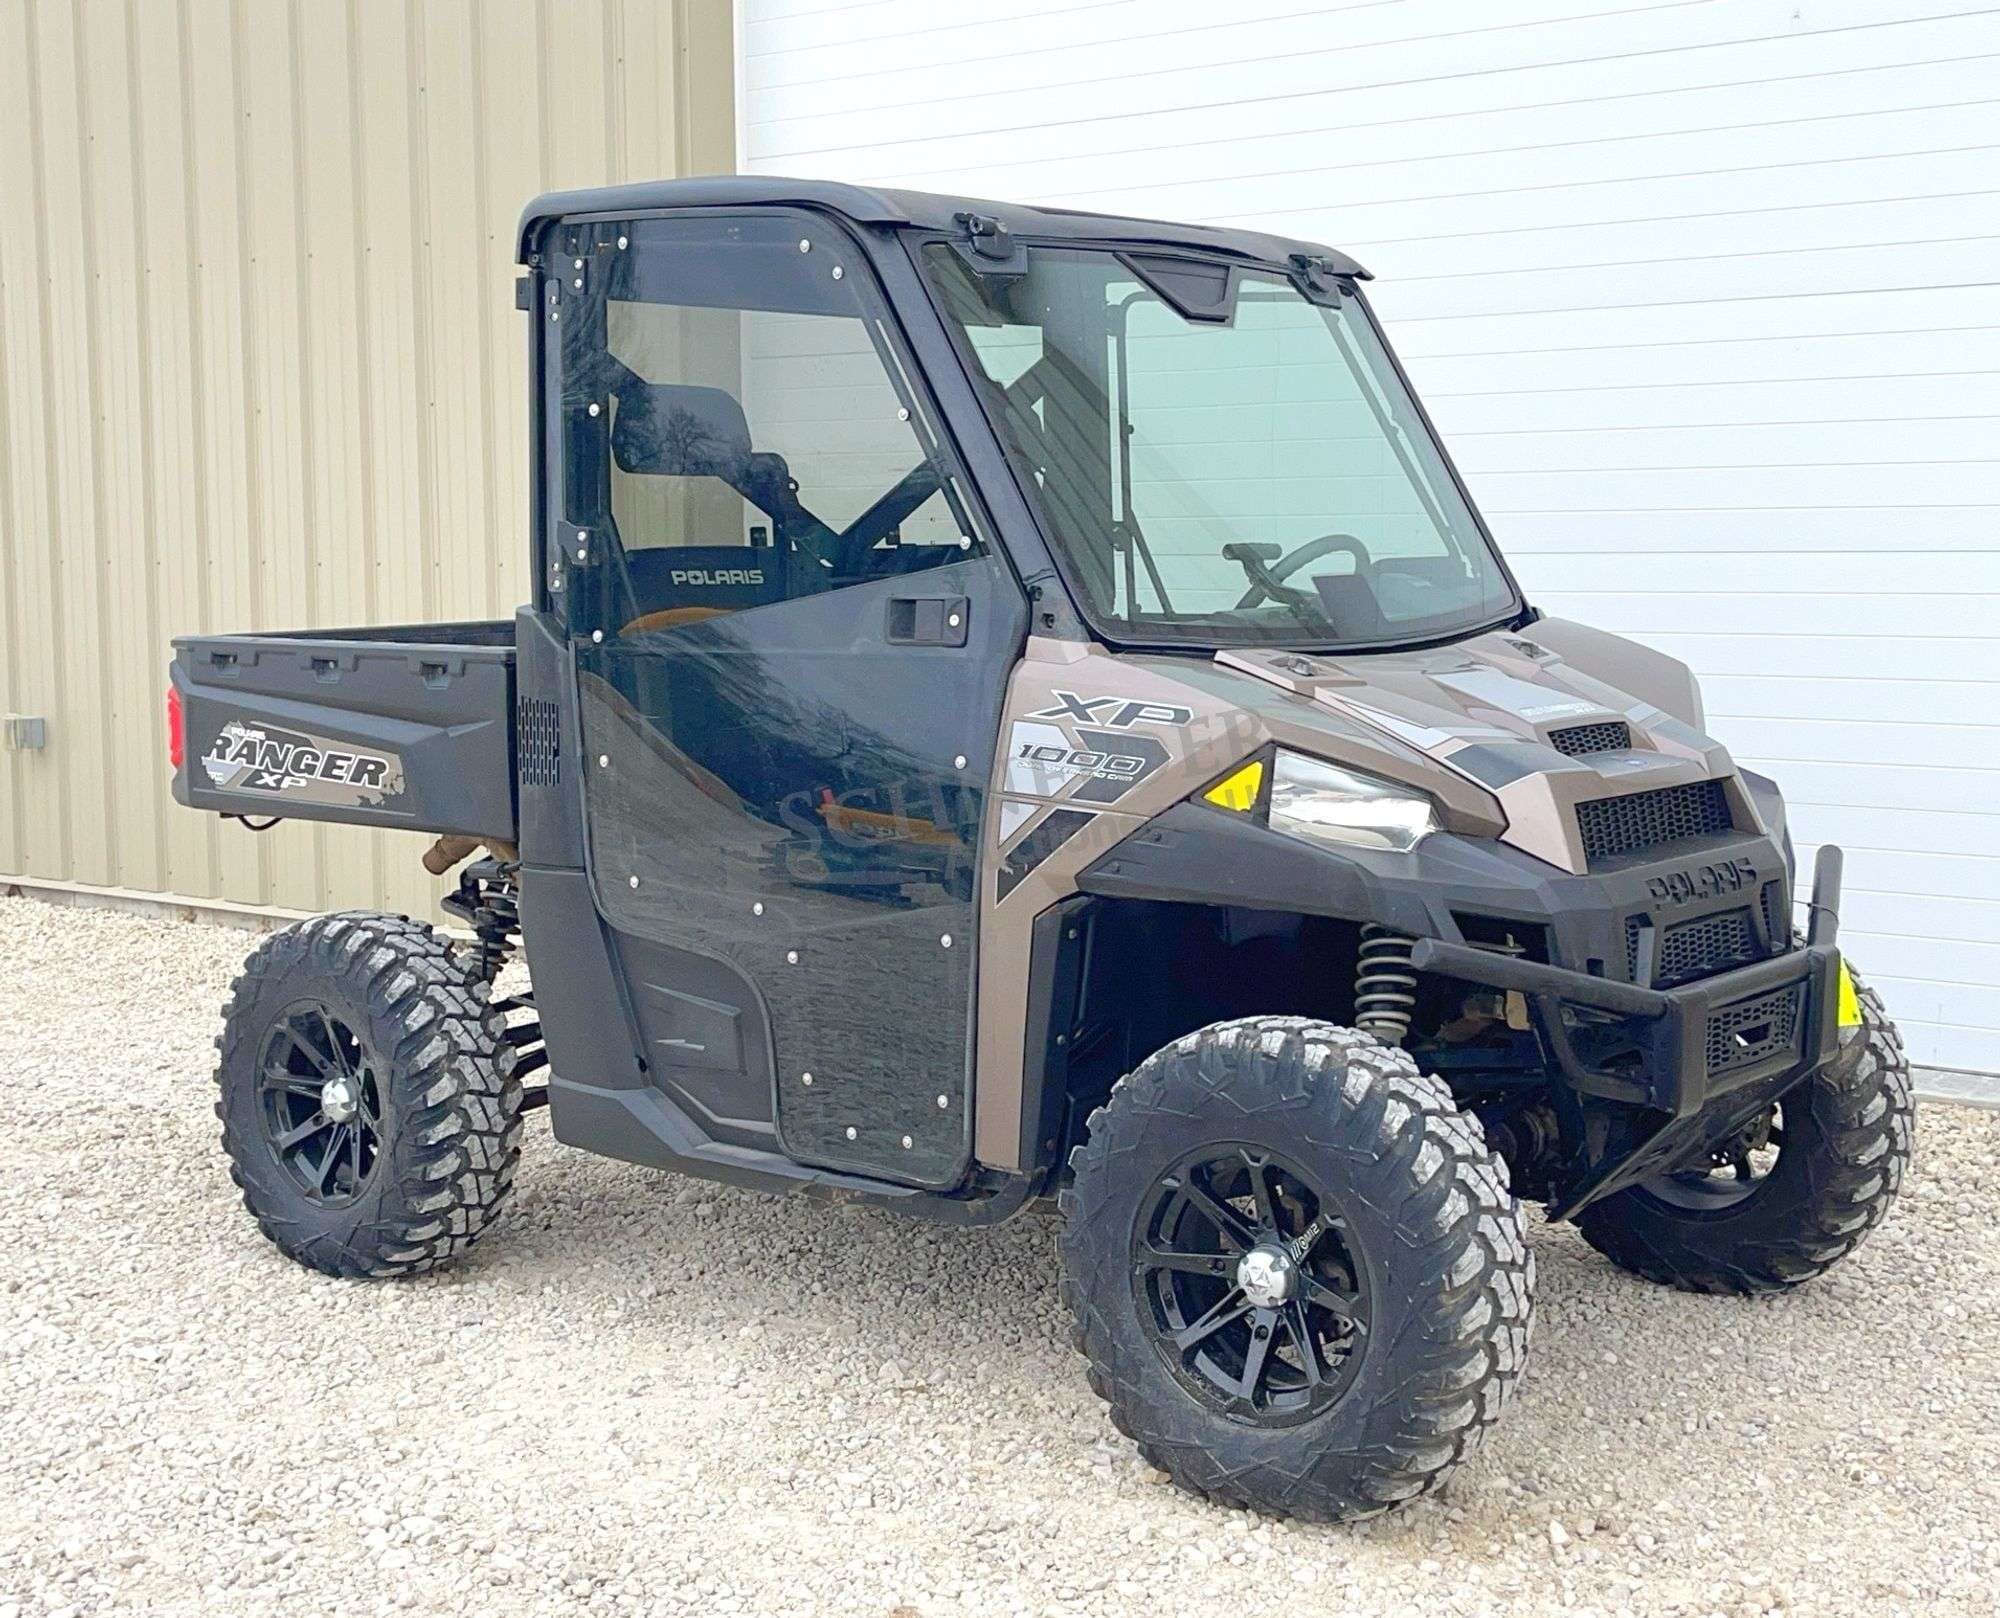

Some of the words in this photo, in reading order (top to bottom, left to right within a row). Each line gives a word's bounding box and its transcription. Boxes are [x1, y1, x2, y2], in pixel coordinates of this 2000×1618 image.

[671, 569, 764, 585] POLARIS
[1023, 688, 1195, 728] XP
[201, 732, 390, 789] RANGER
[1018, 743, 1146, 776] 1000
[255, 771, 308, 790] XP
[1646, 857, 1757, 911] POLARIS
